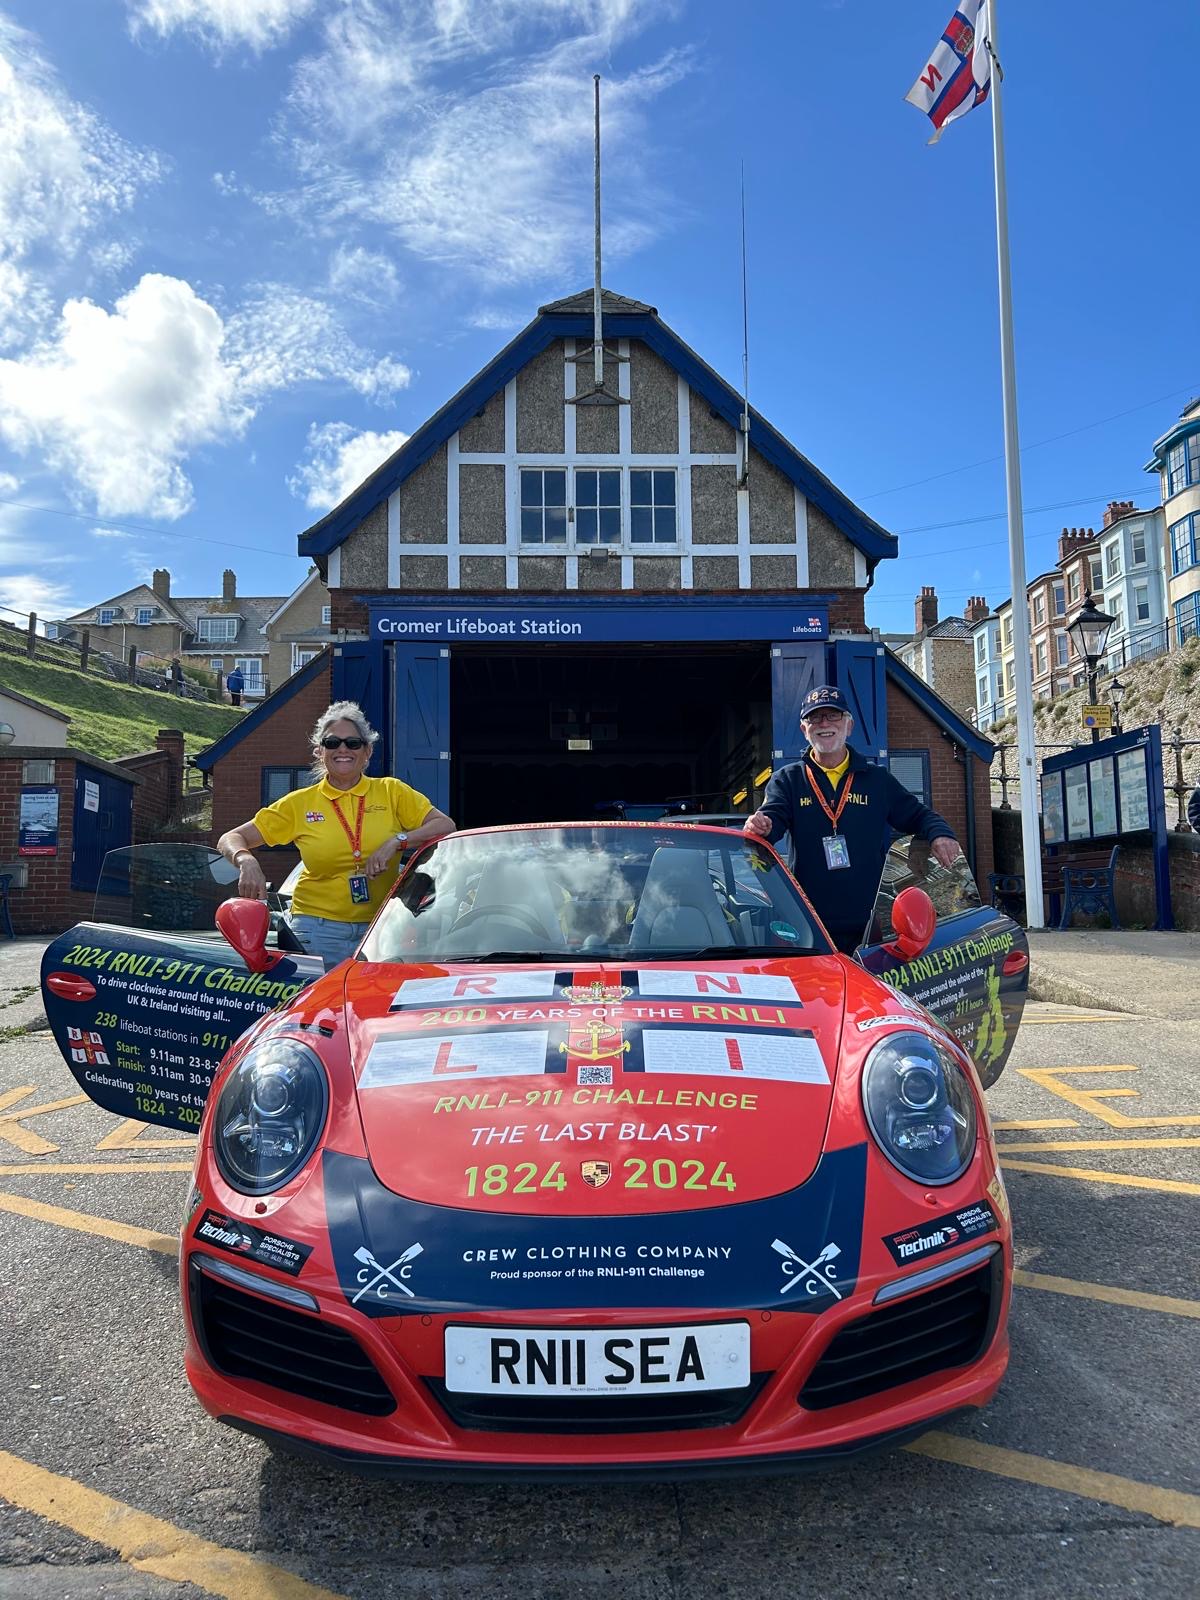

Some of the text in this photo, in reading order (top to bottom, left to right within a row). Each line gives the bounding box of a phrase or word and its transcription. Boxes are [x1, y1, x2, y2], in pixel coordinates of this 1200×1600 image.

[377, 618, 582, 635] Cromer Lifeboat Station
[807, 689, 839, 704] 1824
[847, 793, 868, 805] RNLI
[908, 945, 966, 984] RNLI-911
[965, 930, 1014, 962] Challenge
[62, 944, 302, 1001] 2024 RNLI-911 Challeng
[930, 980, 948, 996] around
[948, 978, 957, 988] the
[957, 972, 971, 984] whole
[97, 975, 271, 1014] To drive clockwise around the whole of the
[453, 976, 498, 997] R
[694, 975, 742, 995] N
[127, 994, 231, 1022] UK & Ireland visiting all...
[940, 993, 958, 1006] visiting
[956, 998, 969, 1017] 911
[969, 998, 984, 1010] hours
[419, 1005, 786, 1026] 200 YEARS OF THE RNLI
[95, 1011, 118, 1028] 238
[120, 1019, 152, 1036] lifeboat
[153, 1027, 188, 1043] stations
[190, 1032, 199, 1045] in
[201, 1032, 228, 1050] 911
[116, 1041, 220, 1072] Start: 9.11am 23-8-2
[433, 1042, 478, 1075] L
[725, 1038, 744, 1071] I
[117, 1057, 211, 1087] Finish: 9.11am 30-9
[85, 1070, 134, 1093] Celebrating
[136, 1082, 153, 1095] 200
[154, 1088, 179, 1101] years
[181, 1094, 191, 1104] of
[135, 1097, 166, 1116] 1824
[178, 1106, 201, 1126] 202
[433, 1088, 759, 1114] RNLI-911 CHALLENGE
[472, 1125, 528, 1146] THE
[464, 1158, 737, 1197] 1824 2024
[199, 1221, 241, 1246] Technik
[263, 1235, 295, 1251] PORSCHE
[898, 1231, 946, 1258] Technik
[259, 1242, 301, 1261] SPECIALISTS
[463, 1246, 731, 1262] CREW CLOTHING COMPANY
[357, 1265, 412, 1283] C C
[490, 1266, 705, 1280] Proud sponsor of the RNLI-911 Challenge
[781, 1261, 837, 1279] C C
[377, 1283, 389, 1298] C
[805, 1280, 817, 1295] C
[604, 1335, 706, 1384] SEA
